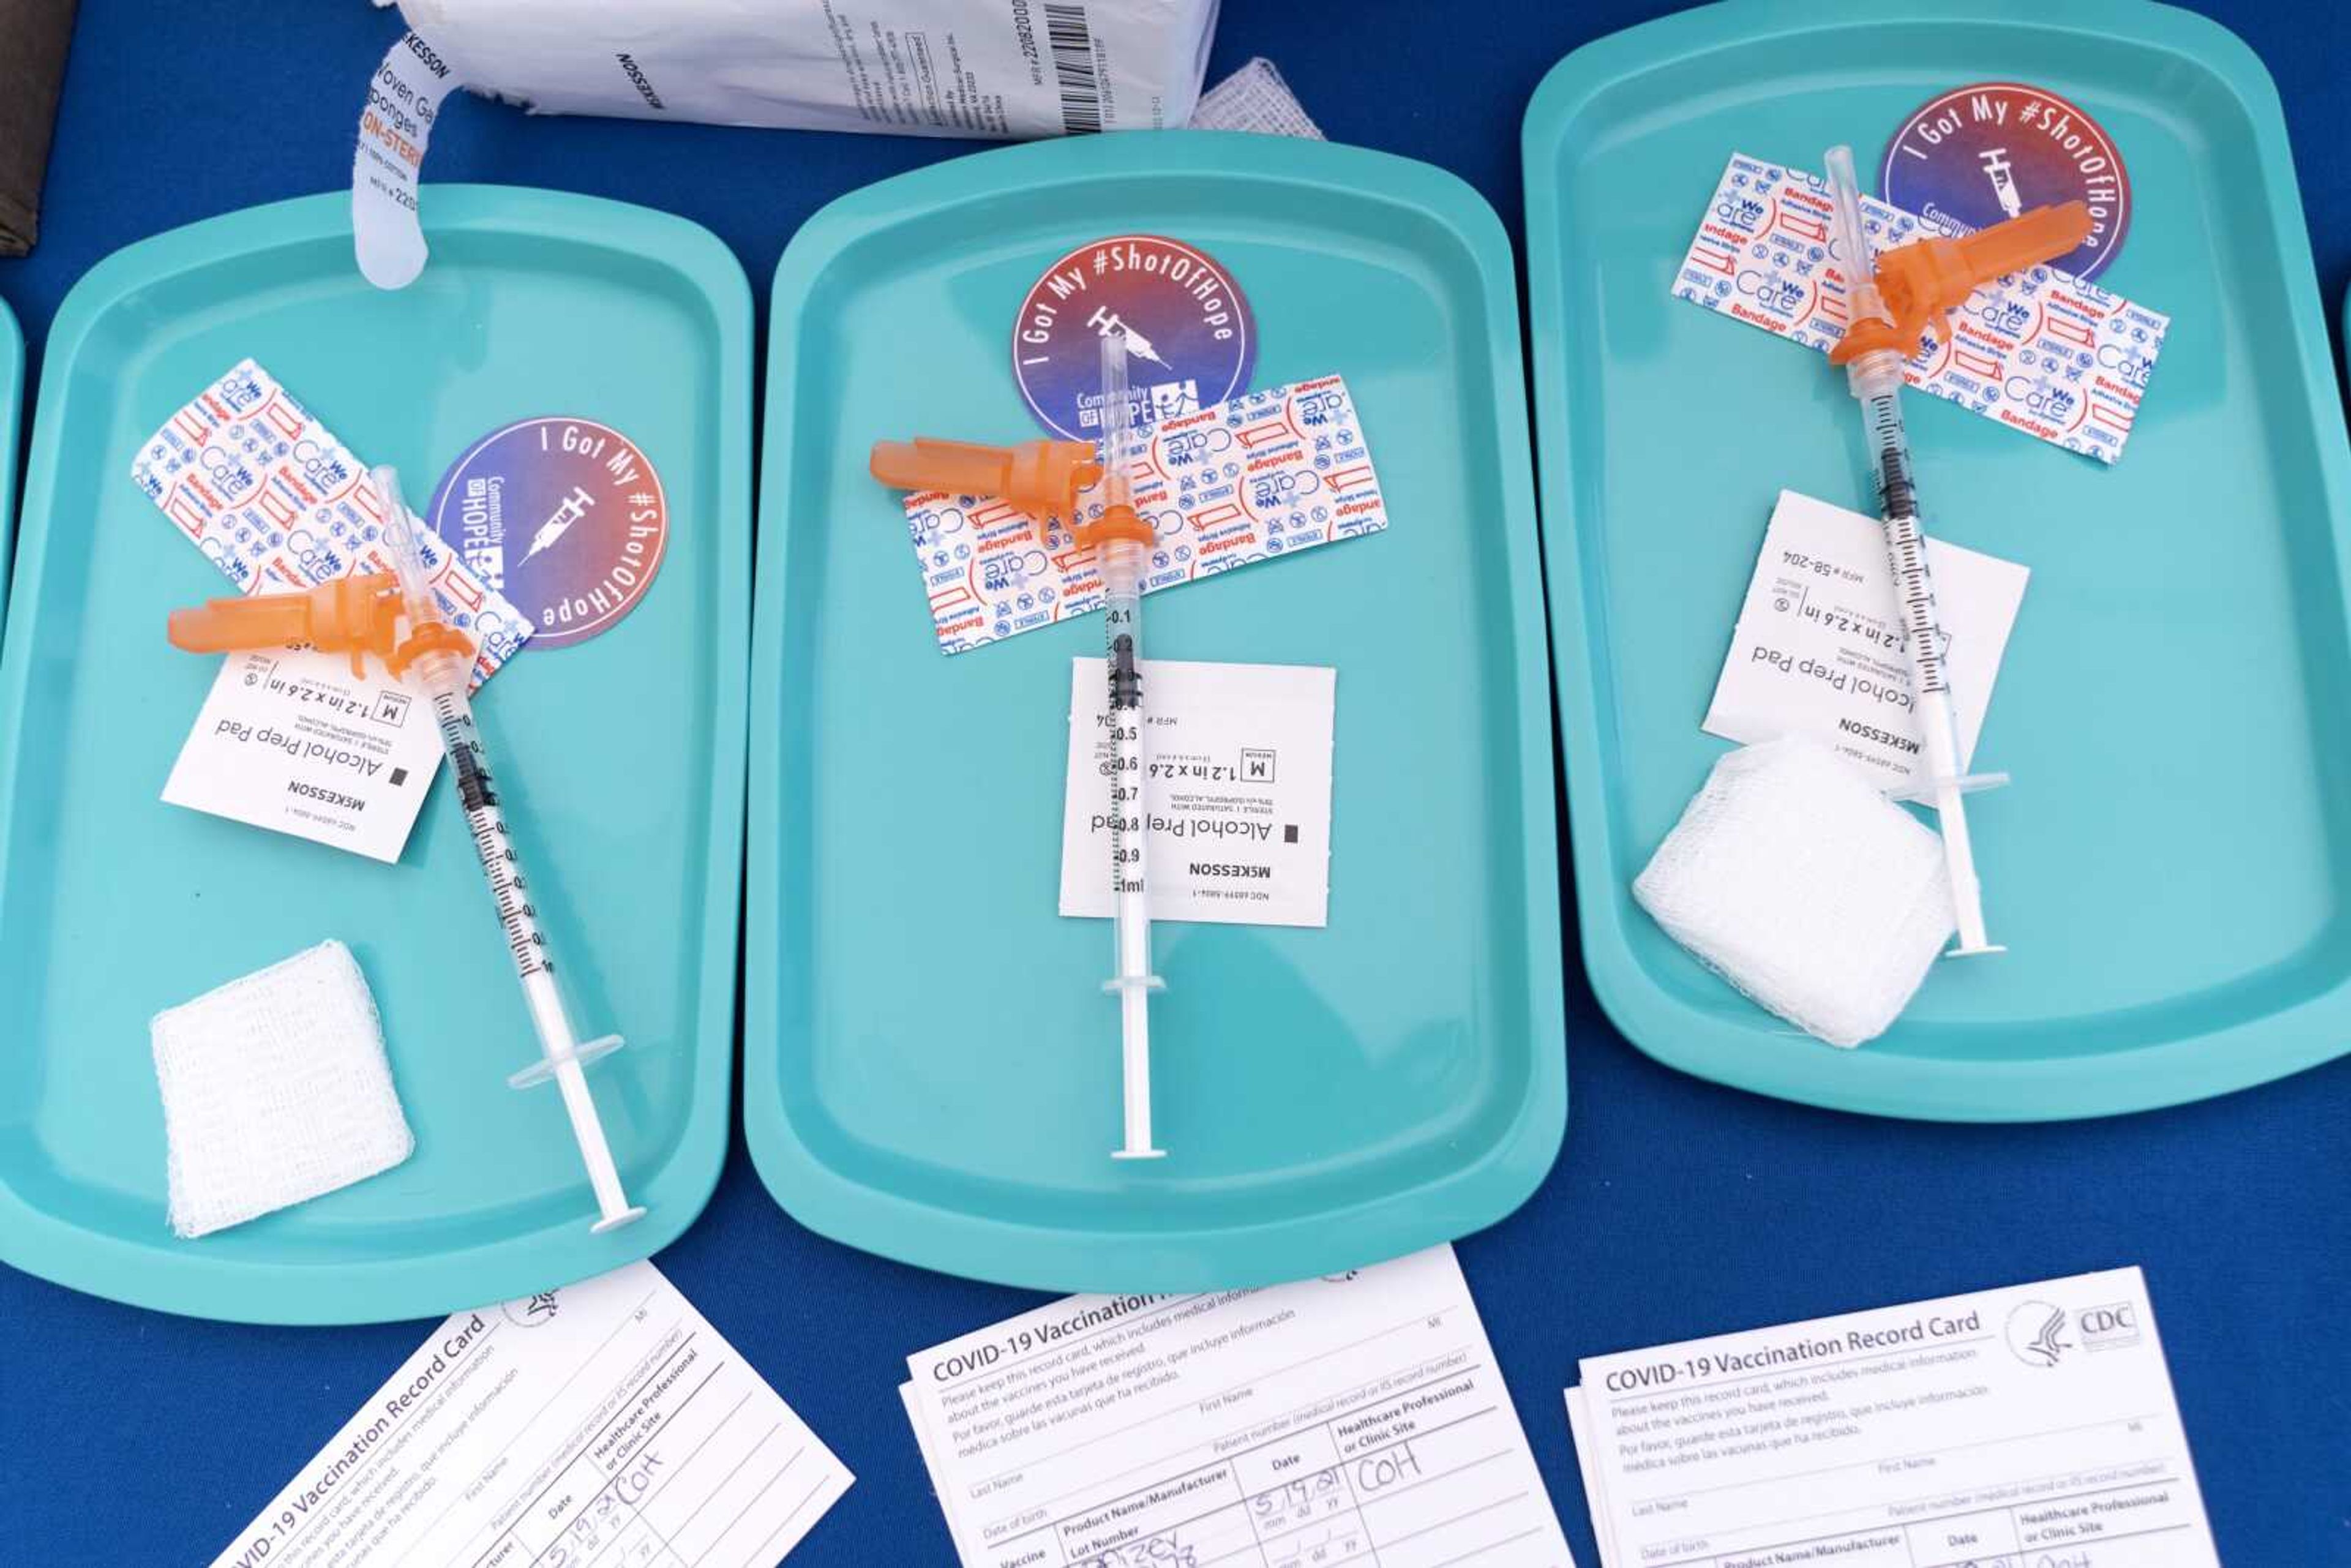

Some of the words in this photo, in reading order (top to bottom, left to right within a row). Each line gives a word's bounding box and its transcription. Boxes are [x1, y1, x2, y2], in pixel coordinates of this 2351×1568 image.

[402, 33, 451, 79] KESSON
[1903, 145, 1928, 160] I
[1917, 109, 1963, 144] Got
[1972, 94, 2008, 125] My
[1742, 200, 1764, 214] We
[1047, 266, 1087, 300] My
[1093, 244, 1233, 340] #ShotOfHope
[1737, 270, 1796, 309] Care
[1782, 281, 1804, 298] We
[2007, 301, 2030, 318] We
[2051, 290, 2104, 319] Bandage
[1023, 302, 1058, 345] Got
[1731, 304, 1787, 331] Bandage
[1959, 321, 2013, 351] Bandage
[1022, 357, 1049, 366] I
[246, 380, 262, 398] We
[2005, 376, 2068, 416] Care
[2053, 388, 2074, 406] We
[1081, 411, 1097, 426] OF
[1163, 411, 1217, 432] Bandage
[1303, 413, 1328, 426] We
[2001, 410, 2058, 440] Bandage
[541, 427, 547, 451] I
[563, 426, 604, 458] Got
[1169, 428, 1232, 454] Care
[200, 446, 245, 494] Care
[293, 440, 337, 488] Care
[331, 460, 348, 481] We
[606, 449, 640, 486] My
[1168, 454, 1193, 466] We
[1248, 450, 1304, 472] Bandage
[237, 467, 253, 486] We
[279, 466, 317, 504] Bandage
[1255, 470, 1320, 497] Care
[187, 473, 224, 510] Bandage
[1255, 496, 1281, 508] We
[487, 476, 505, 544] Community
[462, 498, 489, 553] HOPE
[978, 530, 1033, 553] Bandage
[1199, 533, 1256, 555] Bandage
[288, 530, 331, 579] Care
[325, 551, 341, 571] We
[544, 491, 659, 625] #ShotOfHope
[984, 551, 1047, 579] Care
[1783, 551, 1831, 576] 58-204
[985, 577, 1010, 590] We
[1112, 610, 1130, 623] 0.1
[1804, 605, 1820, 622] in
[1824, 612, 1848, 631] 2.6
[1851, 622, 1861, 633] x
[1865, 627, 1880, 643] in
[1751, 646, 1793, 672] Pad
[269, 679, 286, 693] in
[1798, 658, 1847, 690] Prep
[287, 684, 313, 701] 2.6
[315, 692, 326, 702] x
[328, 696, 343, 710] in
[1851, 677, 1916, 713] lcohol
[345, 700, 368, 718] 1.2
[382, 704, 398, 719] M
[215, 719, 252, 741] Pad
[256, 727, 301, 755] Prep
[1116, 728, 1137, 741] 0.5
[1839, 718, 1919, 754] McKESSON
[303, 742, 382, 776] Alcohol
[1117, 757, 1138, 771] 0.6
[1149, 763, 1174, 778] 2.6
[1178, 765, 1187, 775] x
[1250, 761, 1265, 776] M
[1192, 765, 1207, 779] in
[1212, 766, 1235, 781] 1.2
[288, 781, 364, 811] McKESSON
[1118, 788, 1138, 801] 0.7
[1119, 818, 1139, 832] 0.8
[1191, 819, 1272, 840] Alcohol
[1120, 849, 1140, 863] 0.9
[1189, 863, 1270, 878] McKESSON
[1121, 879, 1144, 894] 1ml
[2080, 1308, 2128, 1334] CDC
[934, 1332, 1032, 1381] COVID-19
[1035, 1294, 1154, 1343] Vaccination
[941, 1389, 976, 1407] Please
[978, 1379, 1005, 1394] keep
[1006, 1371, 1027, 1384] this
[1029, 1355, 1063, 1375] record
[1092, 1333, 1126, 1351] which
[1127, 1316, 1172, 1338] includes
[1174, 1297, 1216, 1320] medical
[1606, 1357, 1711, 1391] COVID-19
[1715, 1340, 1842, 1371] Vaccination
[1847, 1321, 1923, 1349] Record
[1929, 1311, 1979, 1337] Card
[948, 1405, 979, 1424] about
[980, 1398, 999, 1411] the
[1002, 1381, 1048, 1403] vaccines
[1048, 1373, 1070, 1388] you
[1070, 1362, 1097, 1376] have
[1704, 1387, 1741, 1402] record
[1773, 1377, 1808, 1390] which
[1810, 1370, 1858, 1384] includes
[1861, 1361, 1906, 1375] medical
[594, 1408, 644, 1458] Healthcare
[642, 1348, 697, 1408] Professional
[1338, 1409, 1400, 1436] Healthcare
[1402, 1379, 1474, 1412] Professional
[231, 1512, 295, 1568] VID-19
[293, 1418, 389, 1512] Vaccination
[386, 1354, 446, 1418] Record
[444, 1313, 485, 1357] Card
[616, 1431, 643, 1458] Clinic
[640, 1412, 661, 1433] Site
[1344, 1442, 1356, 1453] or
[1358, 1431, 1390, 1447] Clinic
[1392, 1422, 1415, 1435] Site
[1272, 1455, 1299, 1470] Date
[1358, 1442, 1421, 1491] COH
[992, 1473, 1023, 1489] Name
[548, 1495, 571, 1519] Date
[1063, 1512, 1110, 1536] Product
[1111, 1470, 1226, 1517] Name/Manufacturer
[1948, 1534, 1978, 1547] Date
[2020, 1507, 2088, 1524] Healthcare
[2091, 1493, 2169, 1512] Professional
[2041, 1528, 2076, 1540] Clinic
[2078, 1523, 2102, 1533] Site
[1070, 1544, 1090, 1559] Lot
[1092, 1527, 1138, 1550] Number
